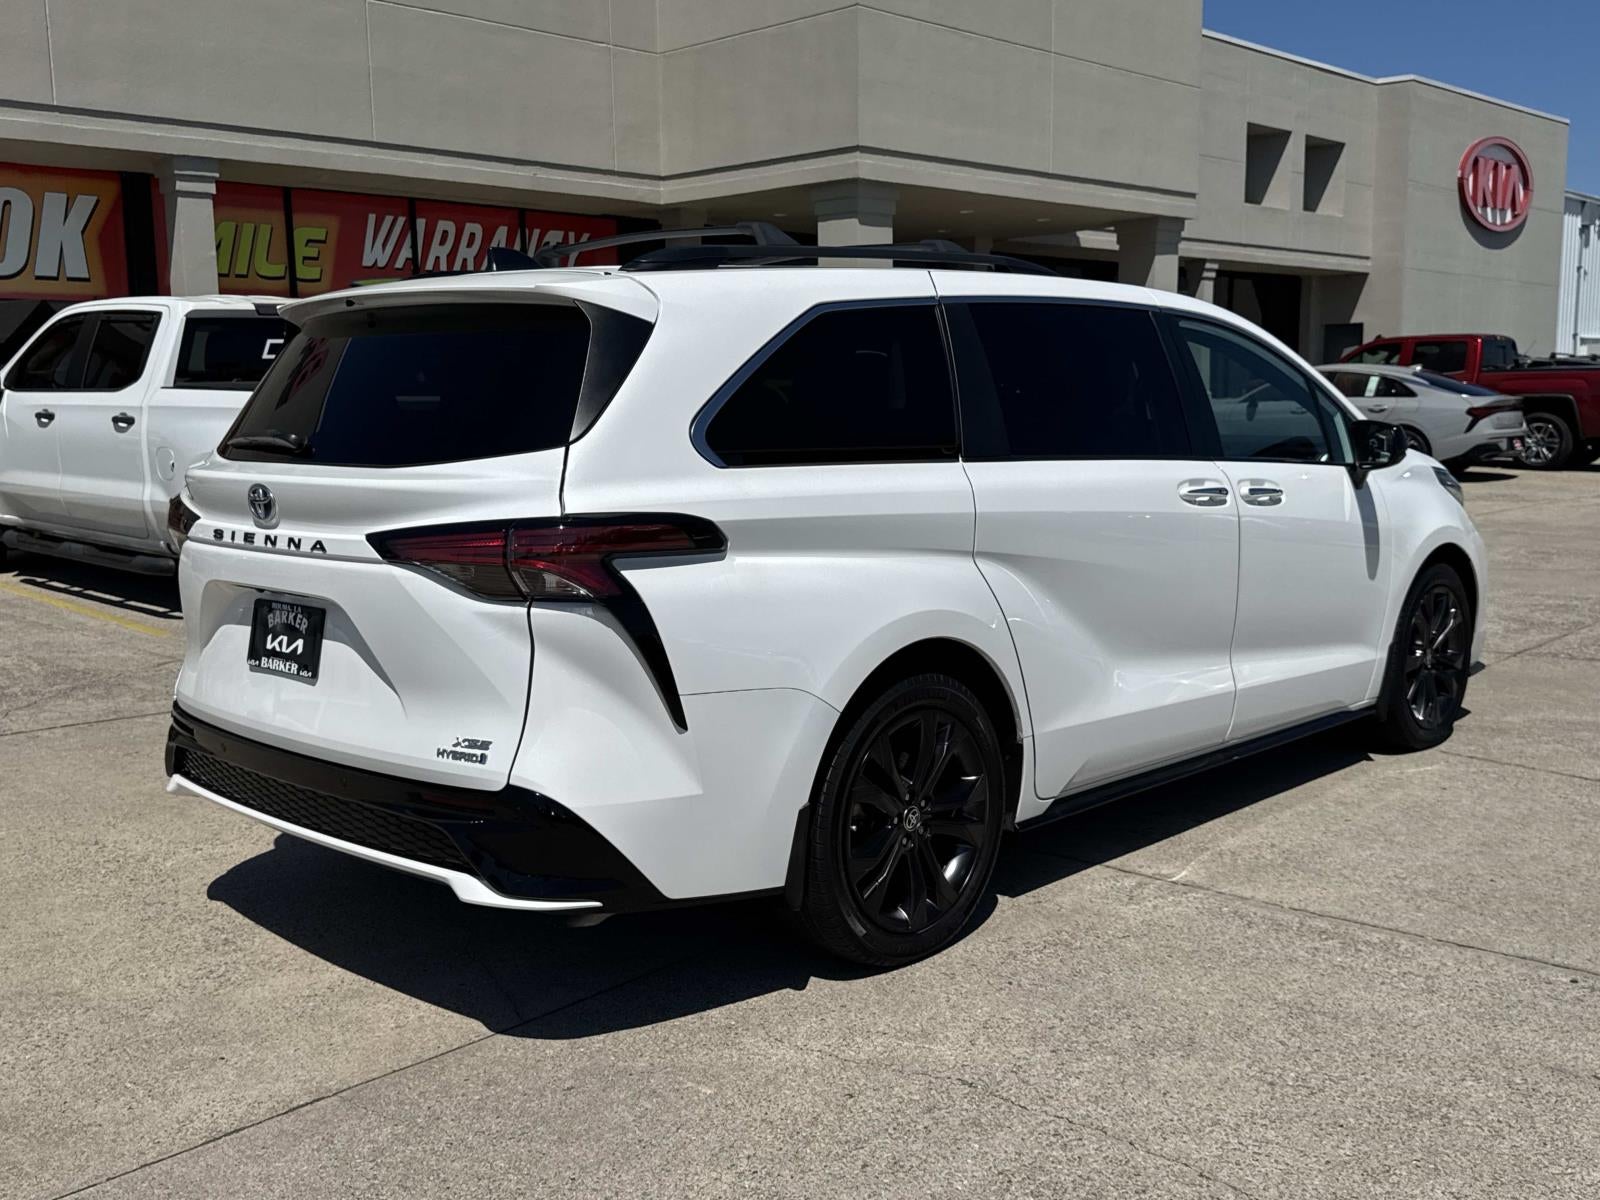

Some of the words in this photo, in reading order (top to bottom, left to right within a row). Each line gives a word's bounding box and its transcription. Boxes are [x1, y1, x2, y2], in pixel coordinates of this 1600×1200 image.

[1471, 156, 1521, 218] KIA
[213, 529, 327, 554] SIENNA
[268, 610, 308, 634] BARKER
[266, 633, 304, 655] KIA
[261, 656, 298, 675] BARKER
